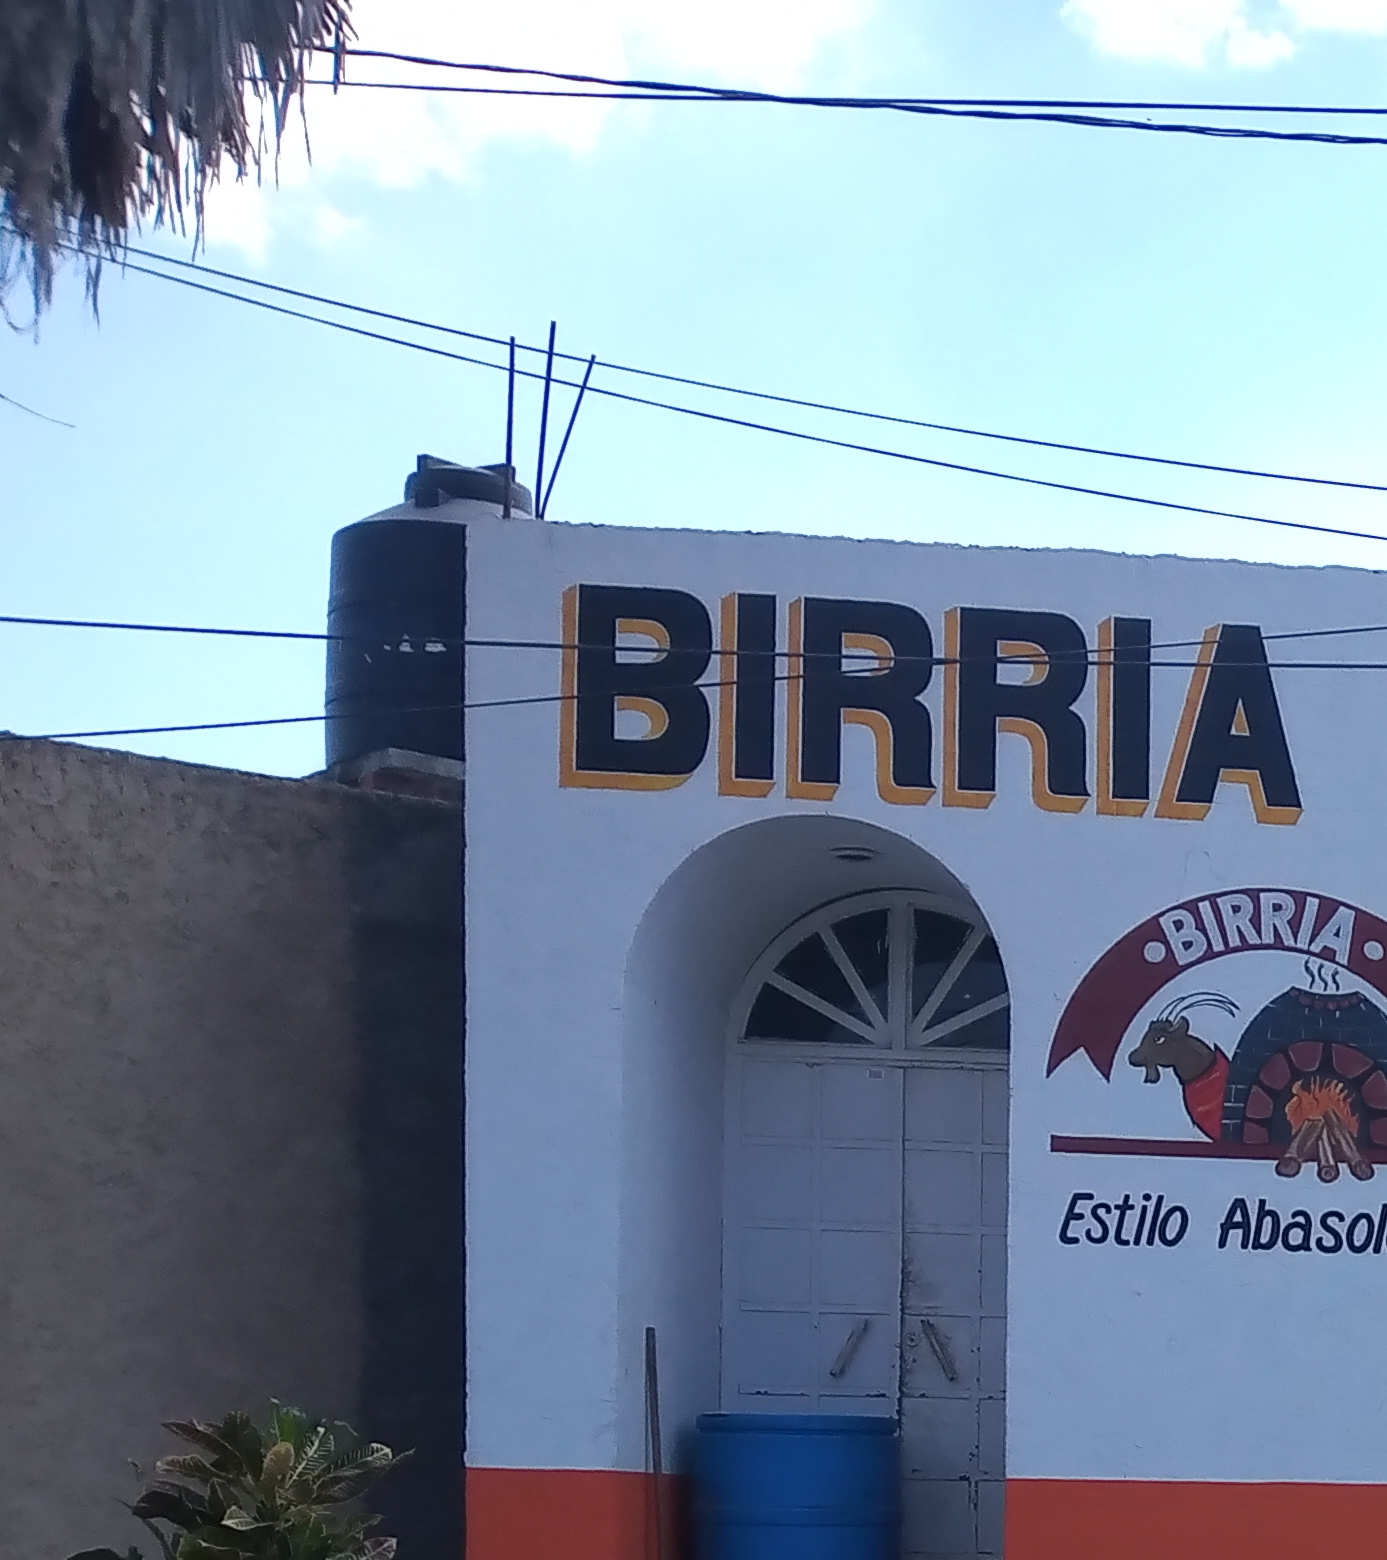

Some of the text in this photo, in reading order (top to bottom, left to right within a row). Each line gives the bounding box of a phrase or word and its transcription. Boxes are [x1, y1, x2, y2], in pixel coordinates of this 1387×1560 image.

[560, 583, 1304, 826] BIRRIA
[1159, 892, 1357, 966] BIRRIA
[1059, 1191, 1190, 1248] Estilo
